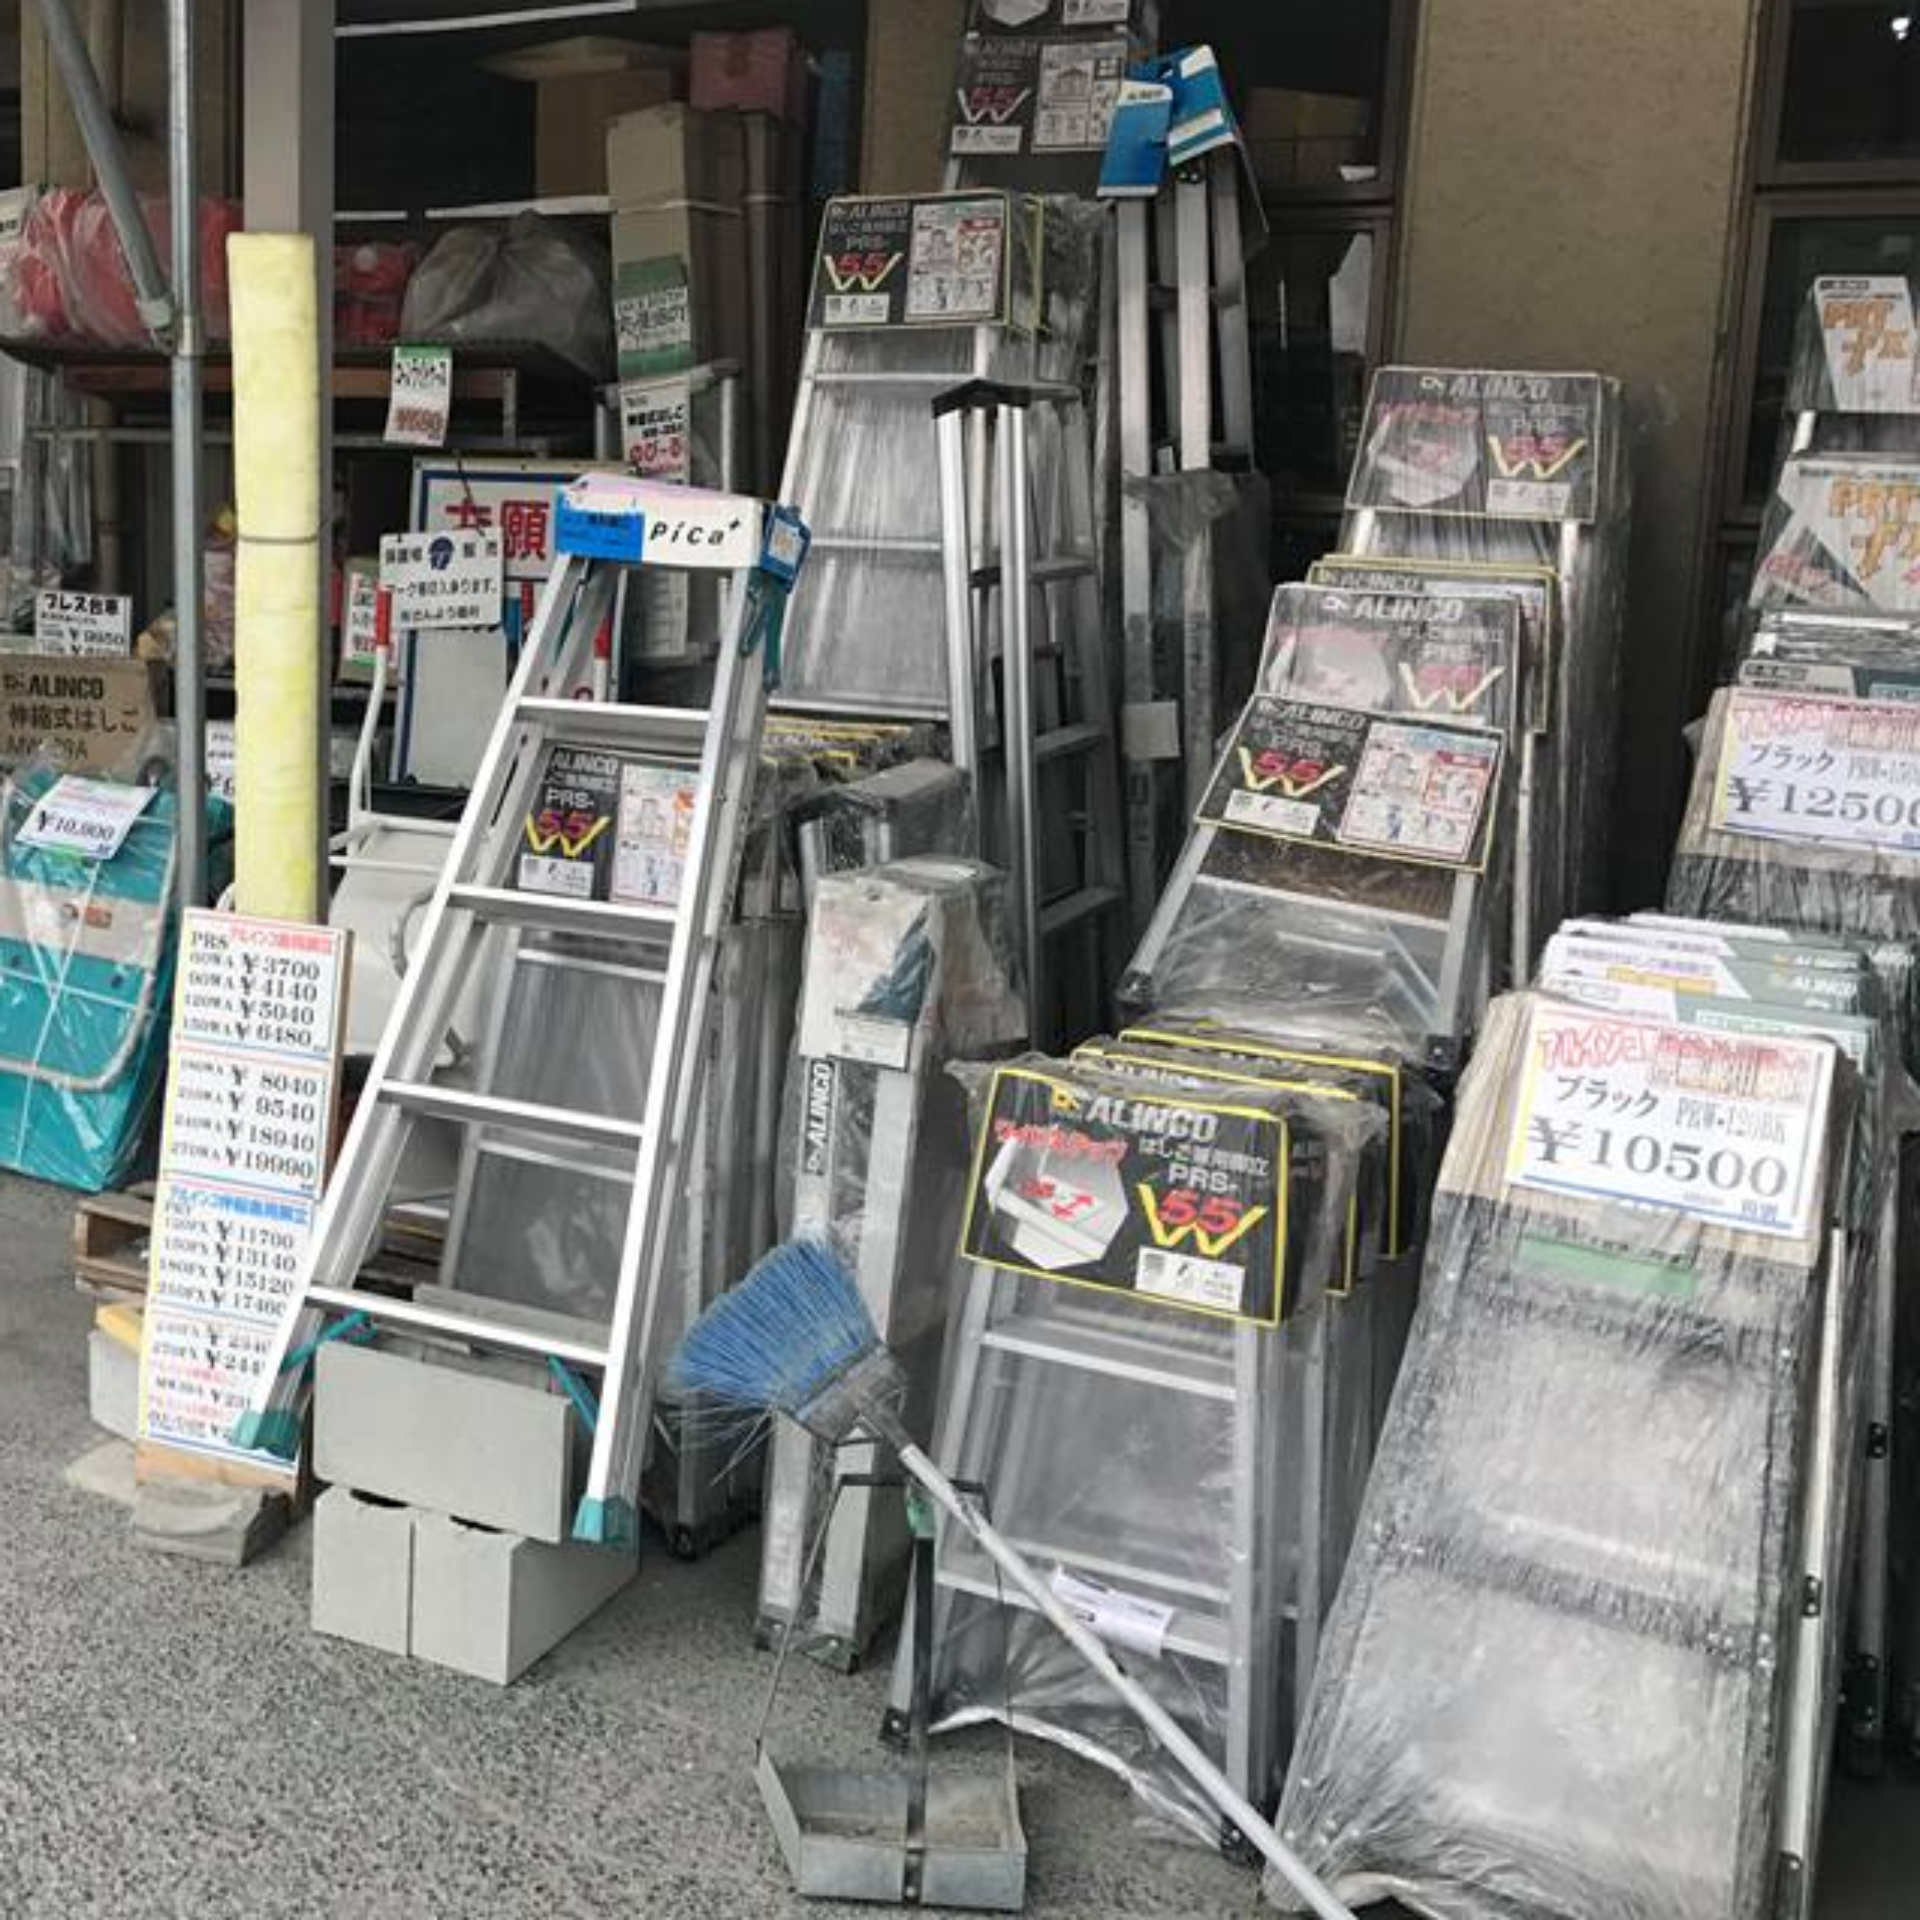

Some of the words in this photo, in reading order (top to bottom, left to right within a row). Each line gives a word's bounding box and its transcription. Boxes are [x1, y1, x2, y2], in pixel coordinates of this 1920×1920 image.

[1353, 597, 1464, 621] ALINCO
[29, 674, 104, 700] ALINCO
[9, 704, 138, 733] 伸縮式はしご
[1275, 701, 1366, 731] ALINCO
[1750, 741, 1835, 776] ブラック
[546, 788, 594, 808] PRS-
[526, 812, 611, 858] W
[538, 808, 593, 837] 55
[190, 930, 229, 950] PRS
[808, 1061, 834, 1149] ALINCO
[1556, 1075, 1660, 1119] ブラック
[1086, 1097, 1218, 1141] ALINCO
[1528, 1114, 1788, 1198] ¥10500
[1167, 1162, 1239, 1193] PRS-
[1137, 1183, 1269, 1256] W
[1159, 1189, 1244, 1234] 55
